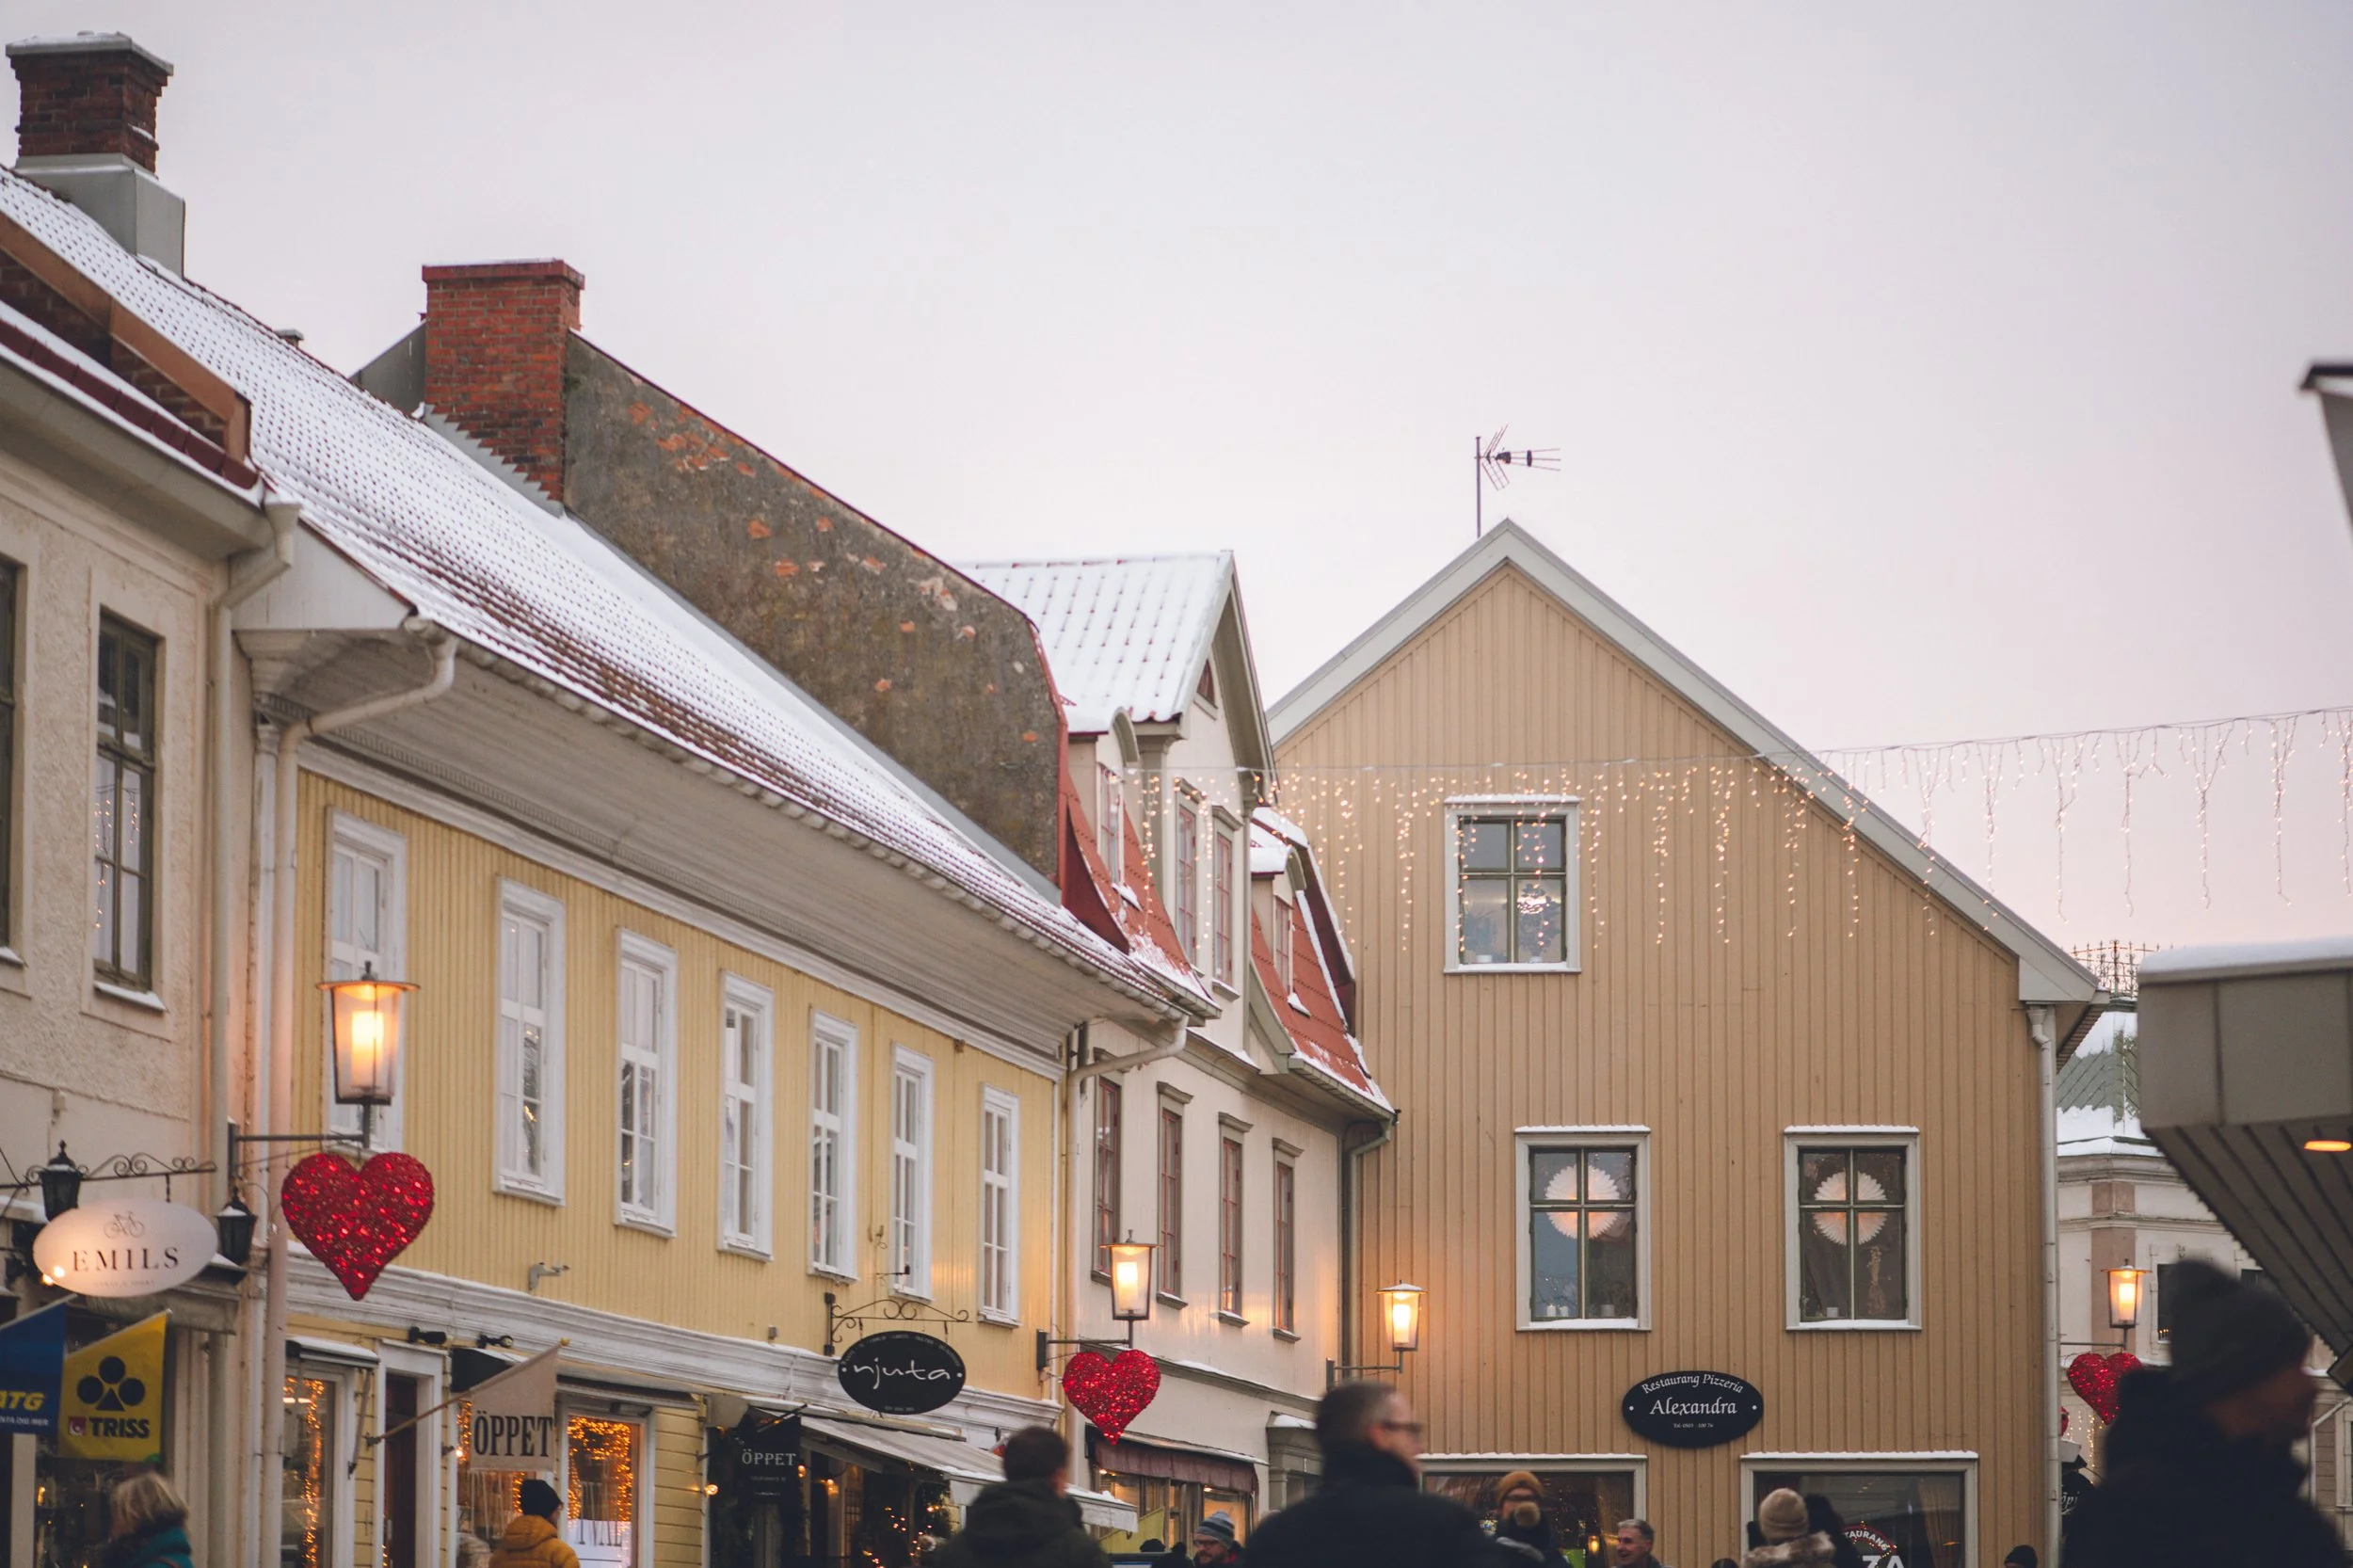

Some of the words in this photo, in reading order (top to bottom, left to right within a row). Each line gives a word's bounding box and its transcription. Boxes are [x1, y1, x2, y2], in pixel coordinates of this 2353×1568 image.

[72, 1247, 179, 1272] EMILS
[853, 1356, 951, 1390] njuta
[1641, 1374, 1701, 1394] Restaurang
[1702, 1374, 1744, 1394] Pizzeria
[1649, 1397, 1738, 1416] Alexandra
[89, 1416, 151, 1438] TRISS
[473, 1410, 553, 1457] ÖPPET
[742, 1448, 797, 1465] ÖPPET
[1843, 1529, 1889, 1551] TAURANG
